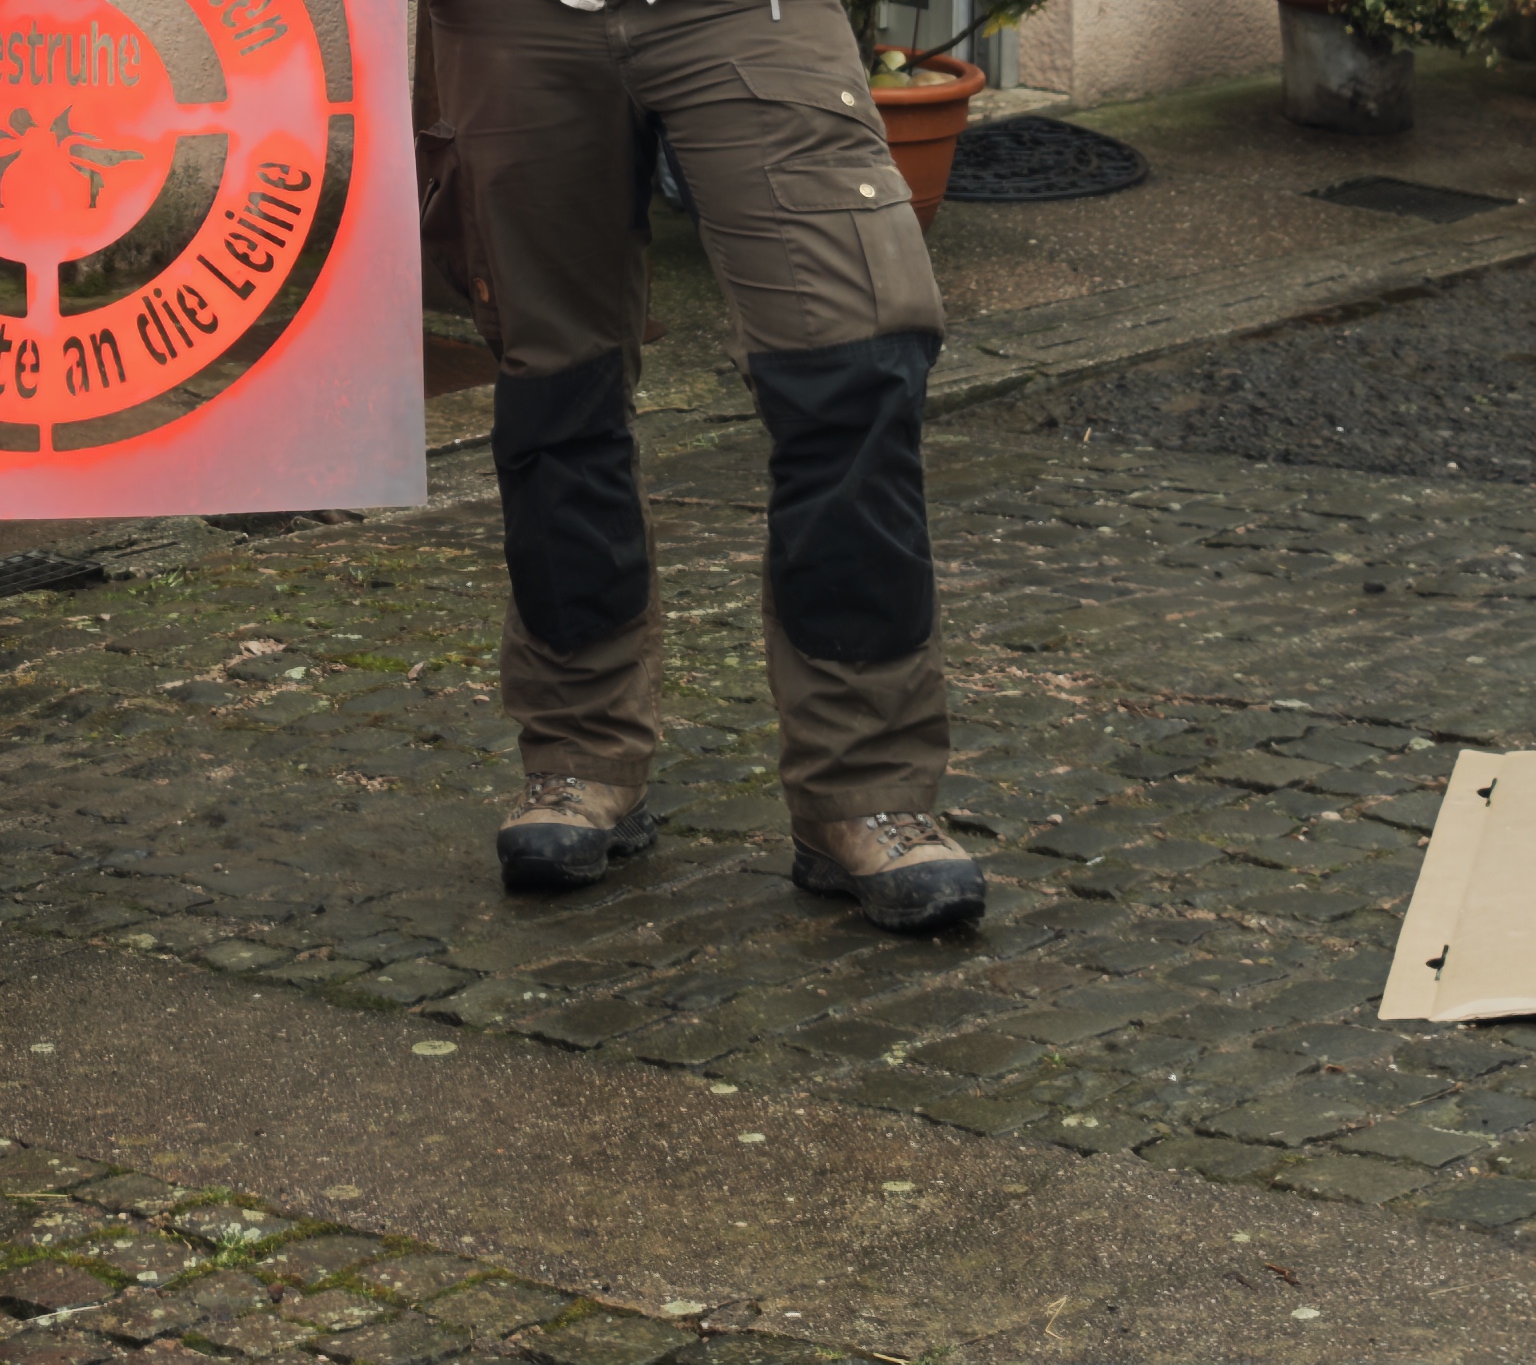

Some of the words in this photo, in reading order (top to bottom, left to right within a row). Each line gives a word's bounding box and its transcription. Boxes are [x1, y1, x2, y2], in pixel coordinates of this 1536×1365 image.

[63, 326, 128, 397] an
[136, 285, 220, 367] die
[197, 161, 312, 302] Leine
